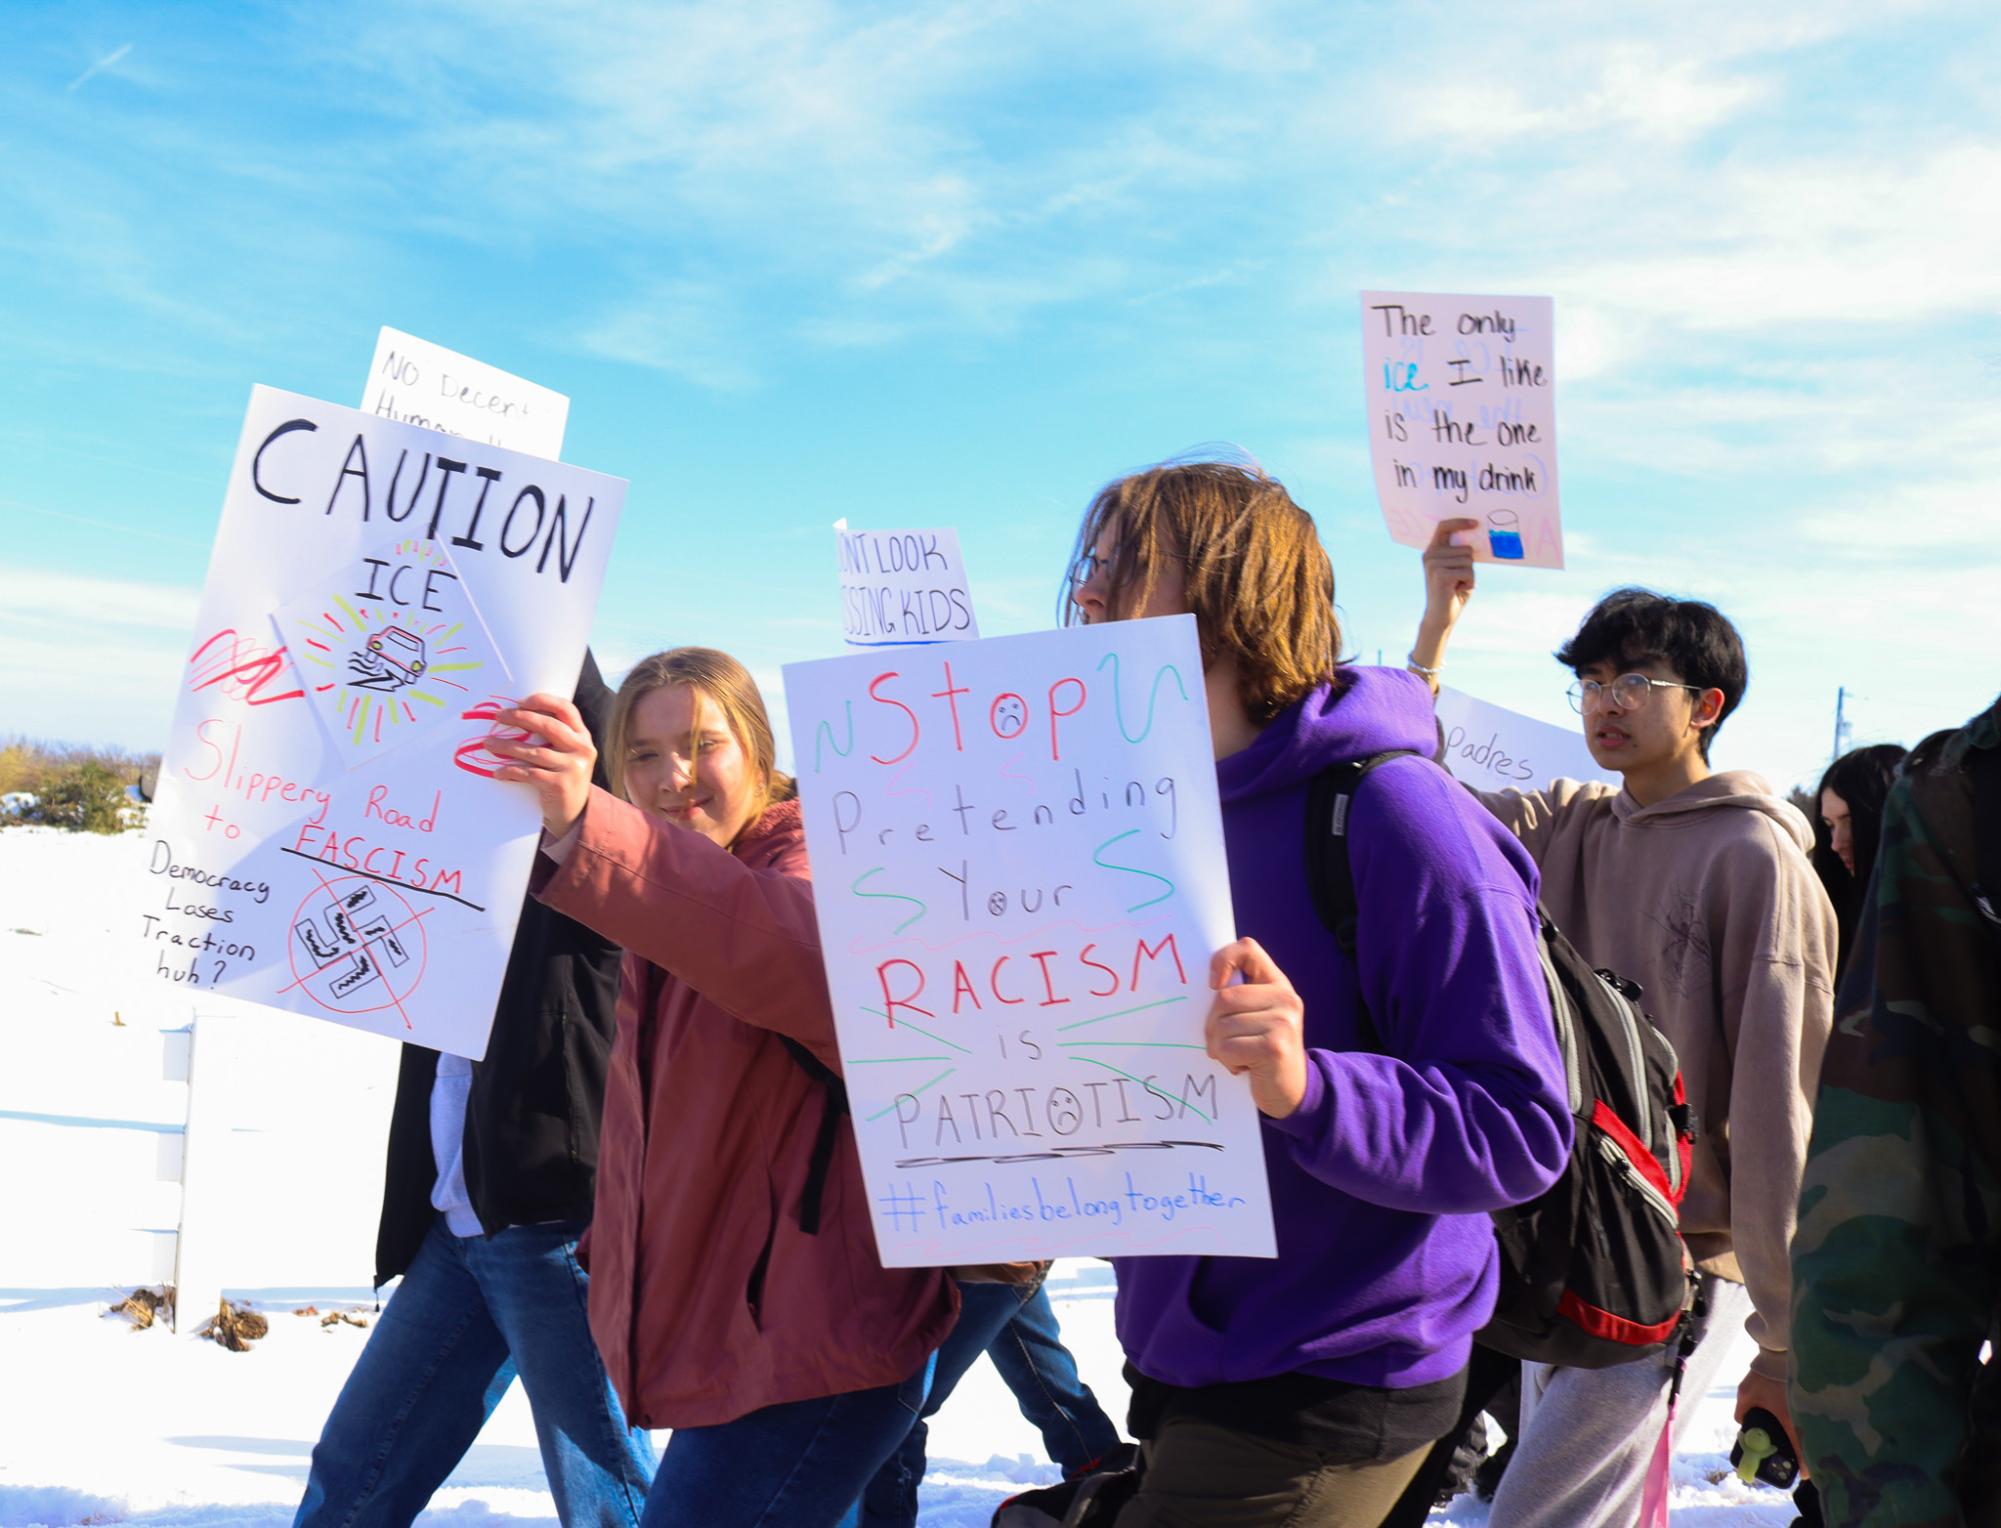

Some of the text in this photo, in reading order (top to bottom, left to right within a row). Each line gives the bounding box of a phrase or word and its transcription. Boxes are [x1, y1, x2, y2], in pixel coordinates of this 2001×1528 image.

[1371, 304, 1516, 343] The only
[1383, 355, 1548, 392] ice I like
[1384, 409, 1542, 447] is the one
[253, 418, 595, 583] CAUTION
[1393, 459, 1537, 503] in my drink
[874, 534, 948, 574] LOOK
[354, 558, 458, 613] ICE
[901, 588, 970, 635] KIDS
[184, 719, 442, 832] Slippery Road
[833, 768, 1178, 854] Pretending
[149, 840, 270, 904] Democracy
[204, 804, 463, 894] to FASCISM
[938, 859, 1074, 921] Your
[143, 914, 255, 961] Traction
[876, 933, 1187, 1029] RACISM
[894, 1073, 1218, 1149] PATRIOTISM
